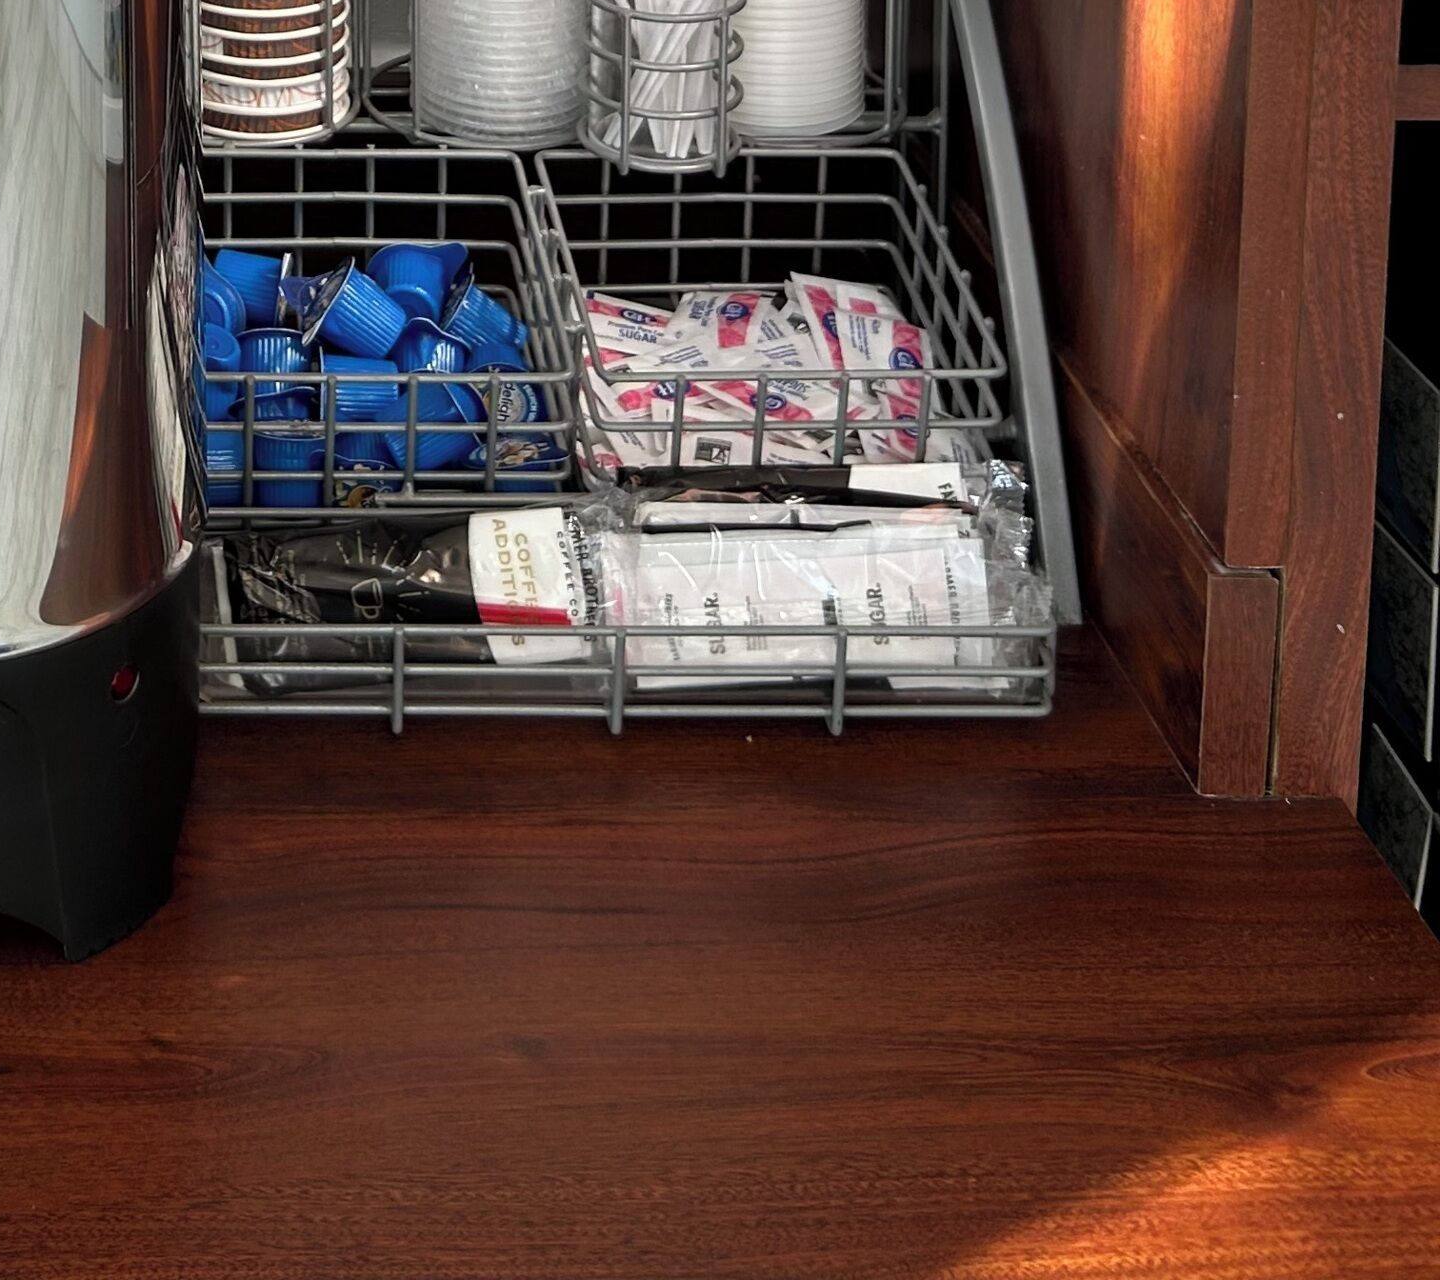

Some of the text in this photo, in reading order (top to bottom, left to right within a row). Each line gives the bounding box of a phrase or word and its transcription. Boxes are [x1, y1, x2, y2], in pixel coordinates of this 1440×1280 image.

[618, 327, 658, 344] SUGAR
[496, 382, 516, 423] deligh
[492, 518, 526, 648] ADDITIOS
[556, 531, 576, 592] COFFEE
[580, 568, 601, 643] BROTHES
